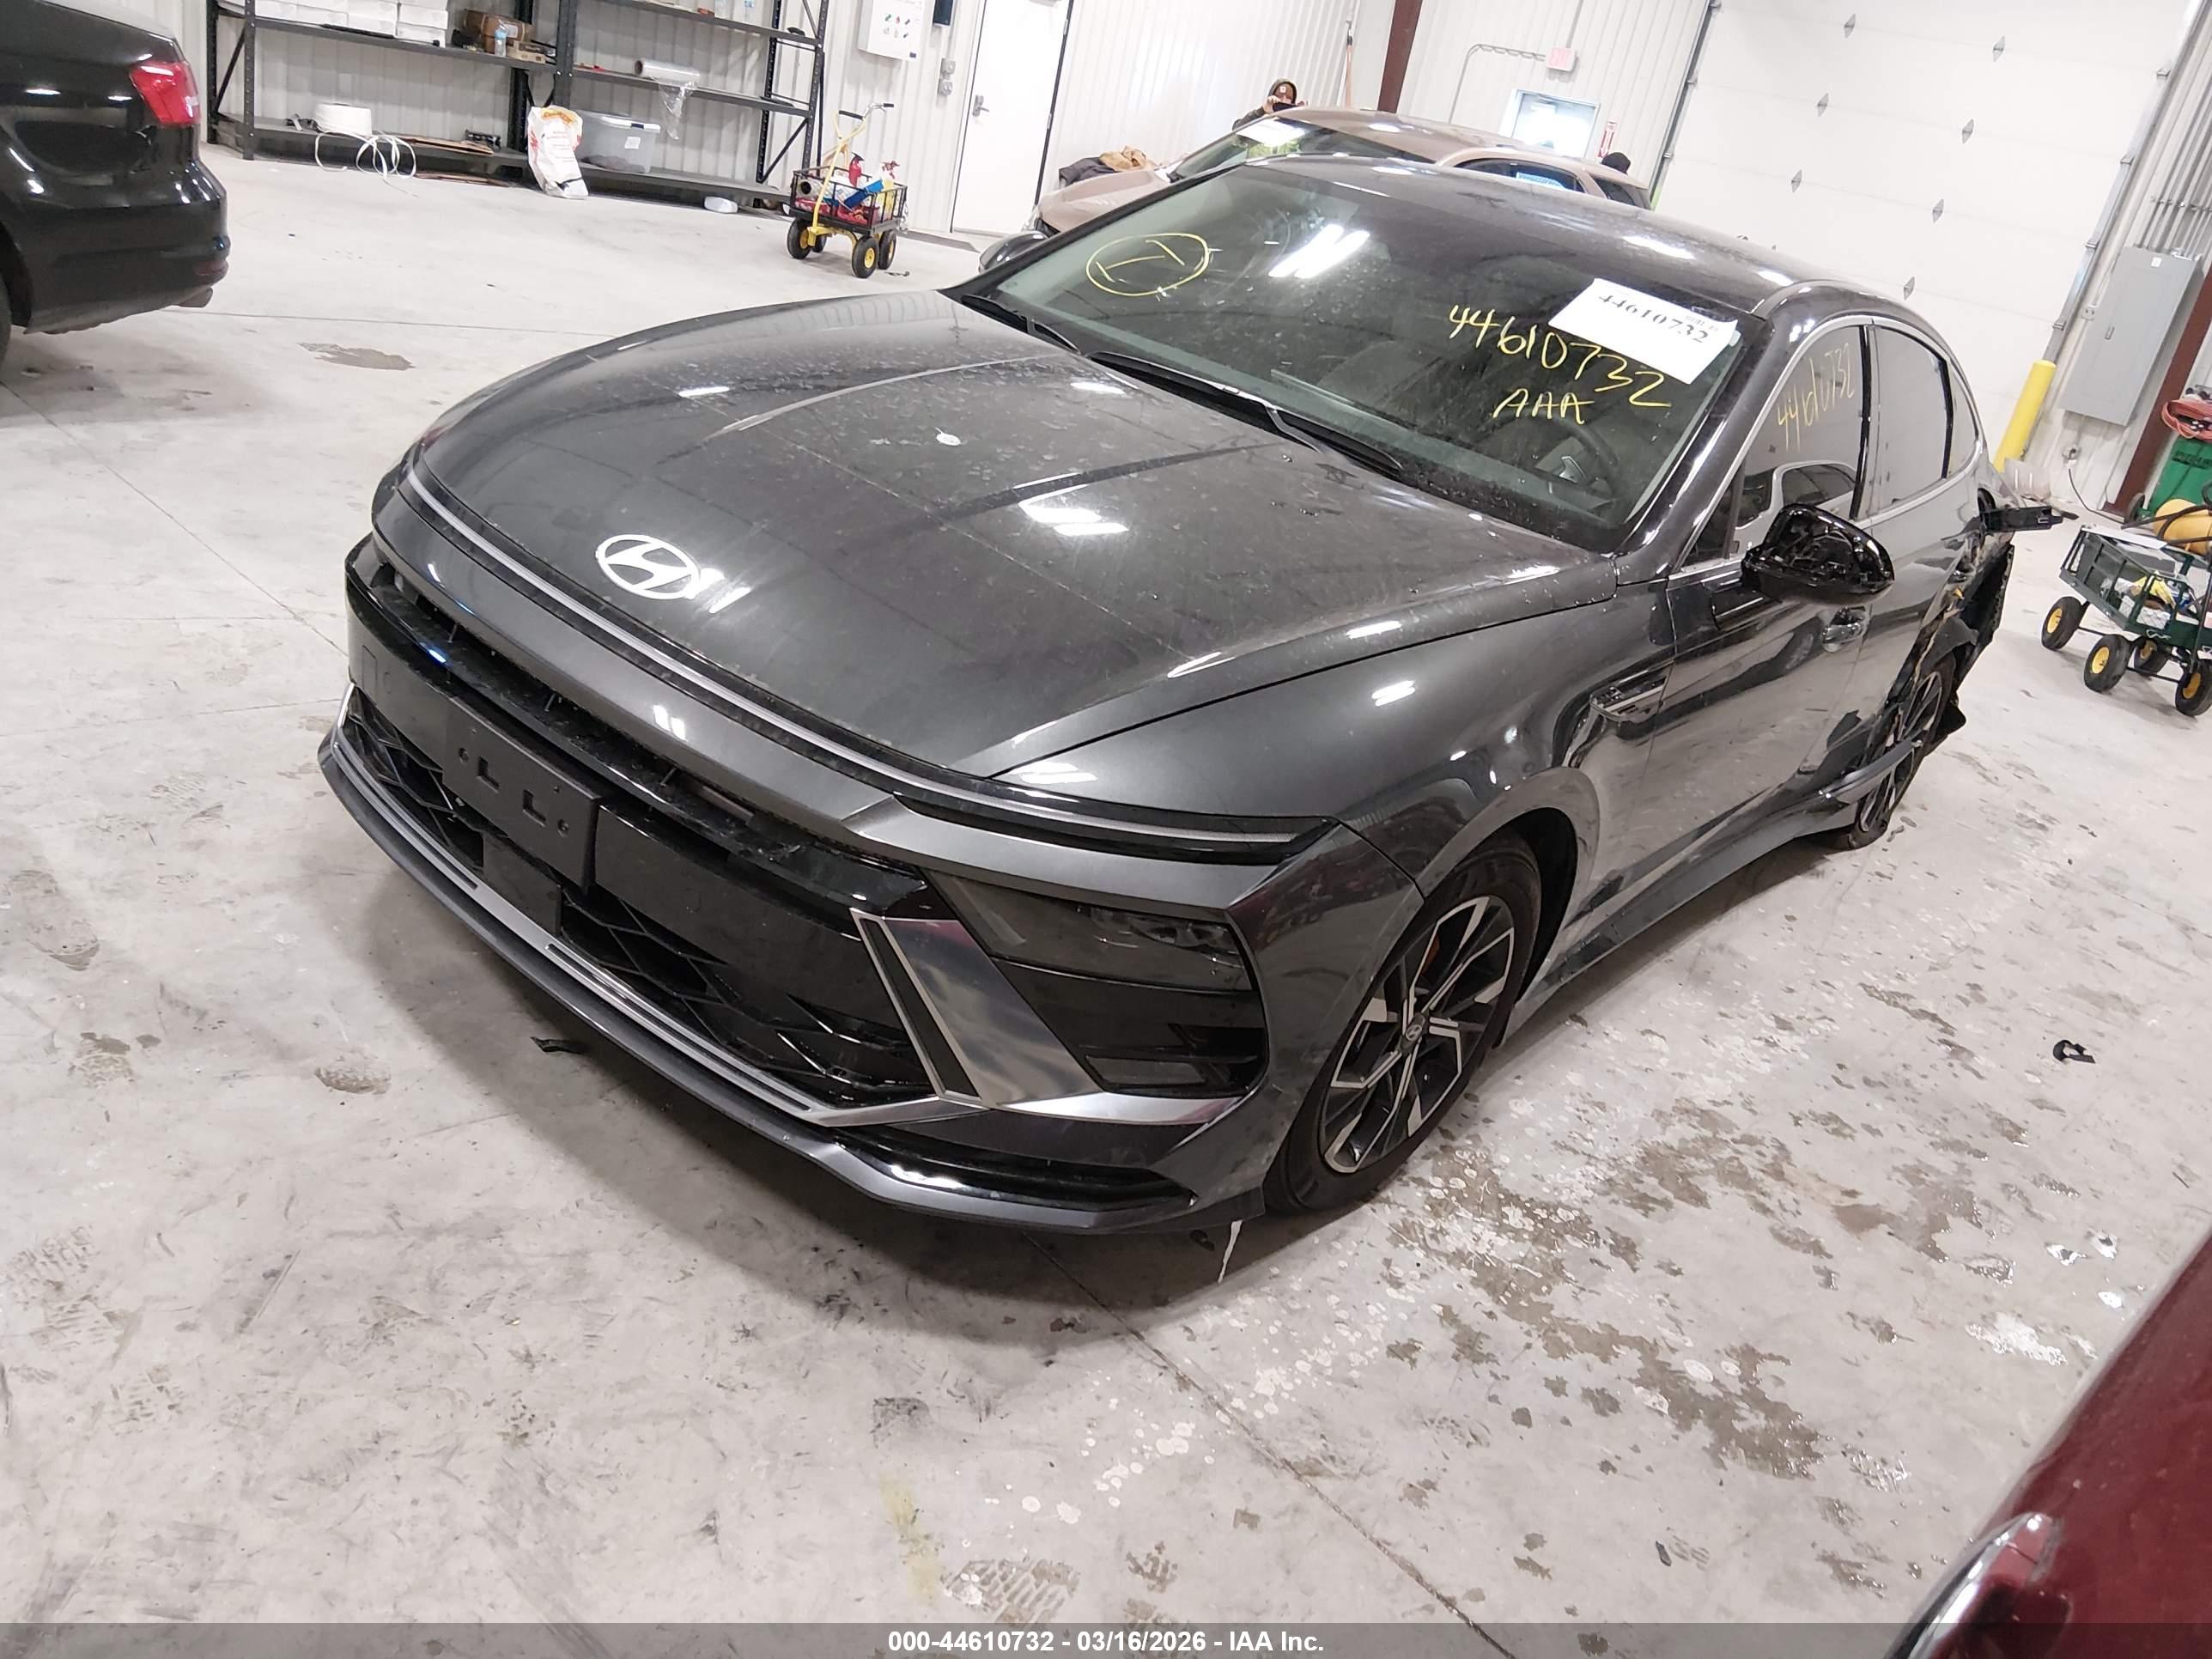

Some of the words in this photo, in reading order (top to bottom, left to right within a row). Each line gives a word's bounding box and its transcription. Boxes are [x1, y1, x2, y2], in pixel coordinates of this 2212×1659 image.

[1598, 294, 1709, 343] 44610732
[1449, 304, 1672, 408] 44610732
[1492, 387, 1595, 425] AAA
